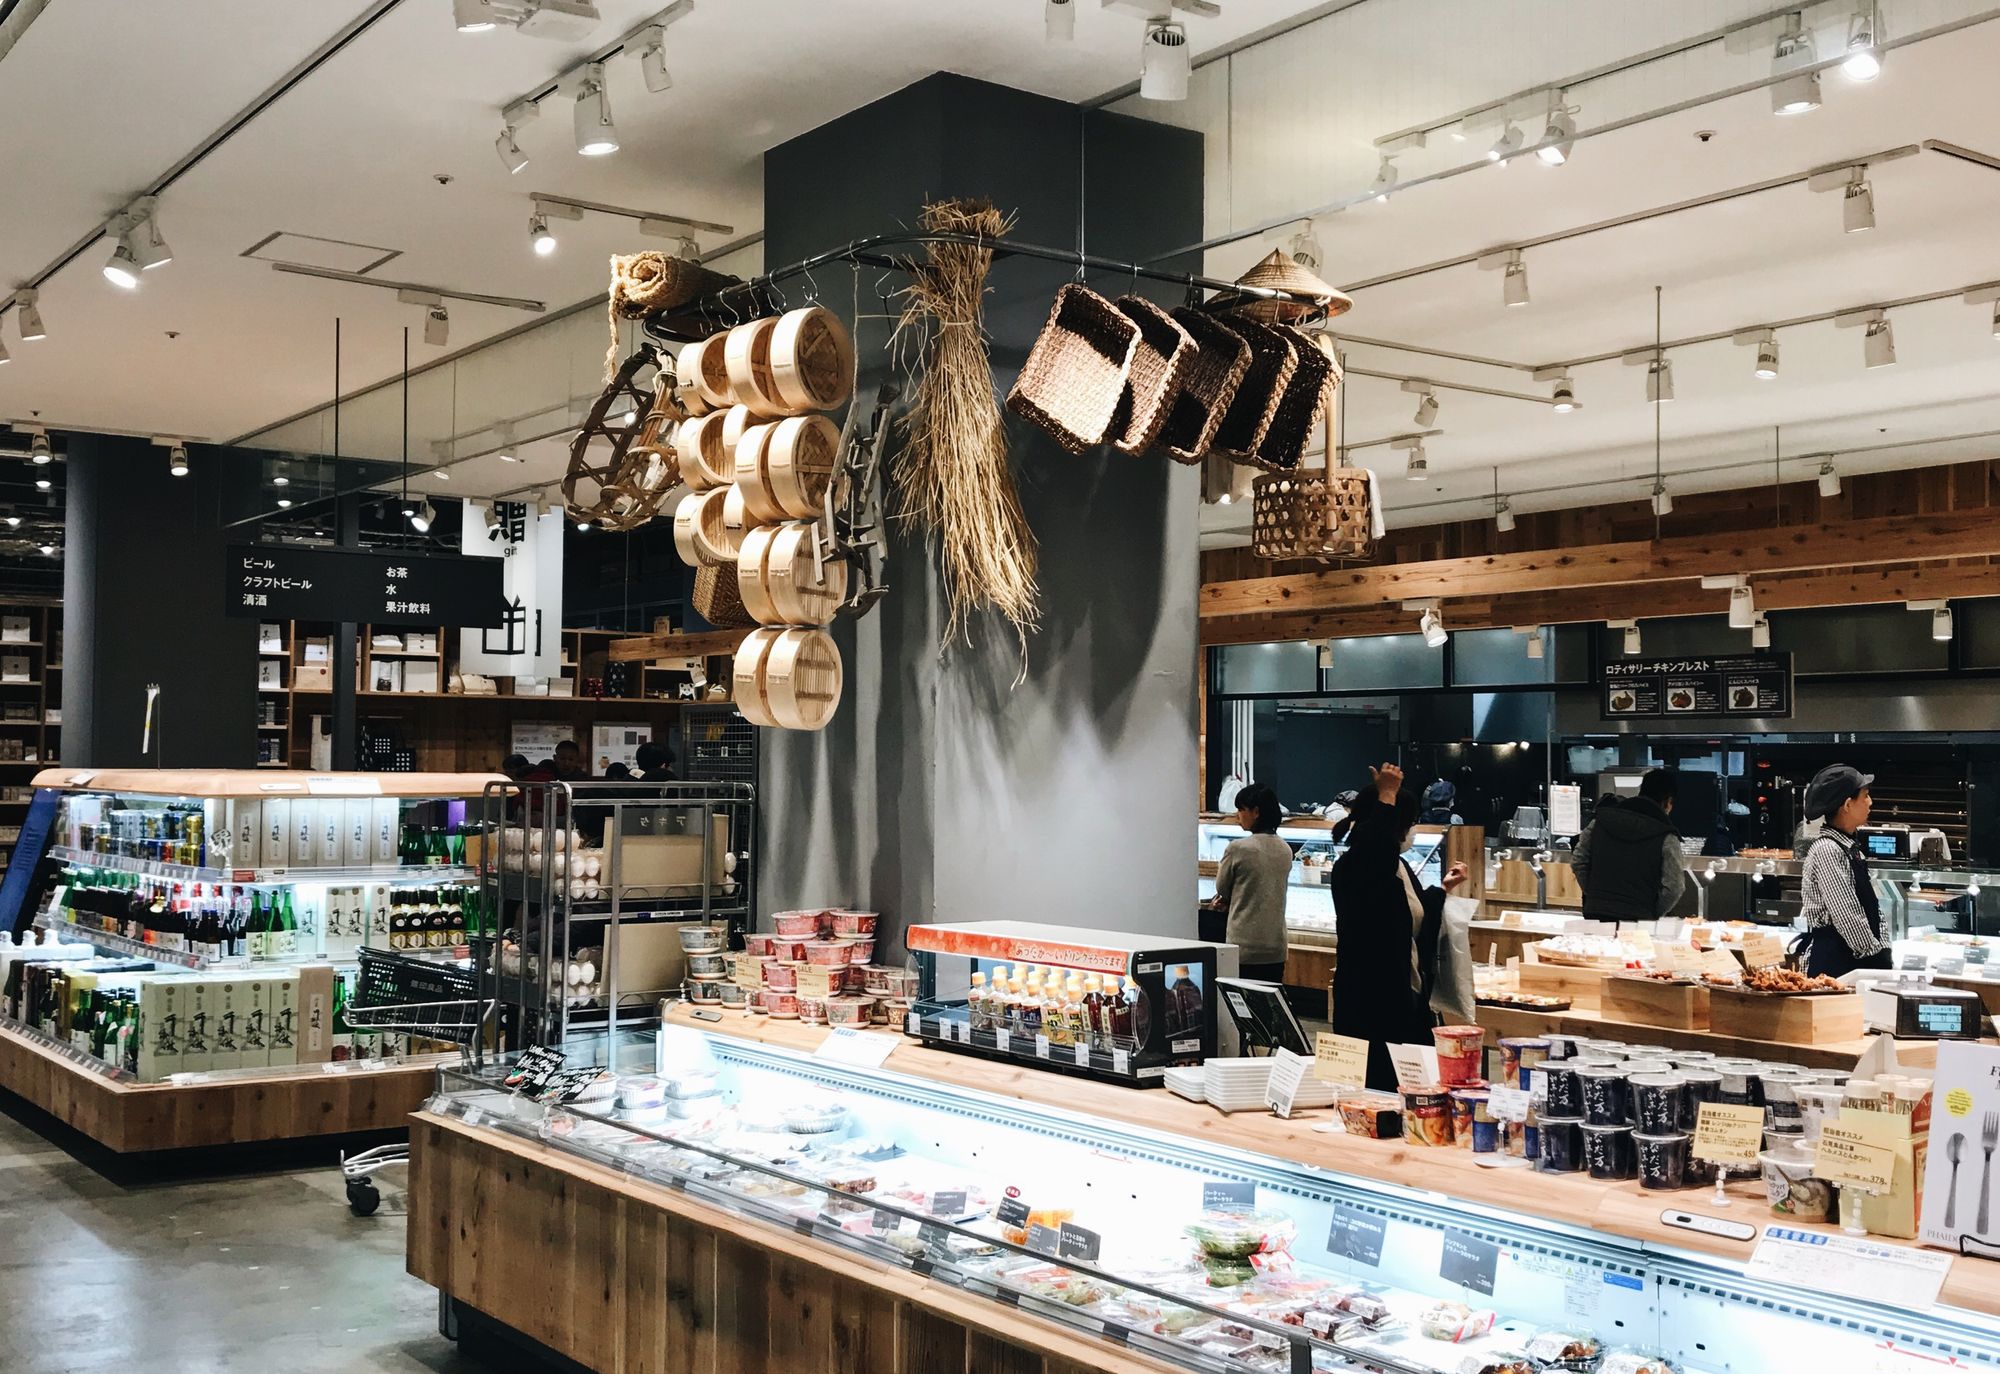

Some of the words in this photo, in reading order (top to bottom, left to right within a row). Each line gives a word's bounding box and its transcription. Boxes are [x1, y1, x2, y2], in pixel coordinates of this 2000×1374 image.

[243, 558, 275, 569] ビール
[386, 566, 408, 579] お茶
[243, 576, 312, 590] クラフトビール
[385, 584, 397, 595] 水
[243, 593, 267, 606] 清酒
[386, 601, 430, 614] 果汁飲料
[1606, 661, 1709, 675] ロティサリーチキンブレスト
[1990, 1065, 2000, 1077] F
[1927, 1229, 1968, 1245] PHAID
